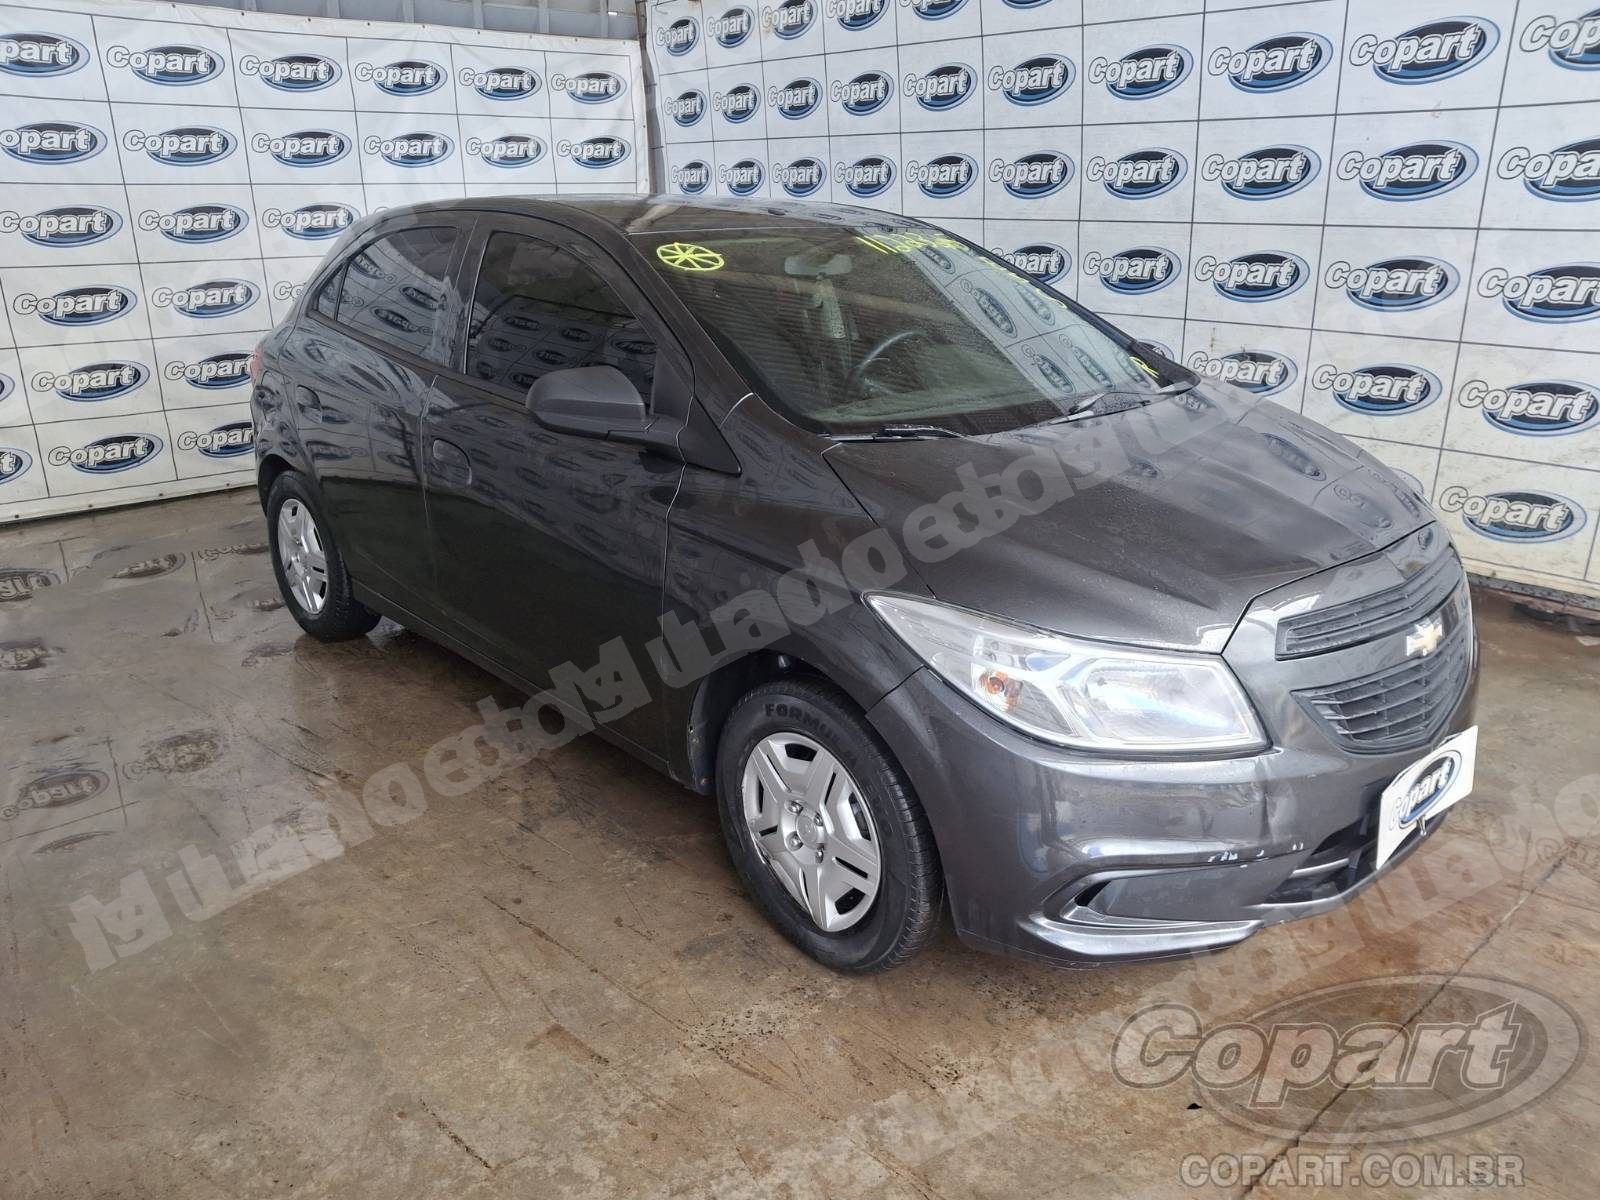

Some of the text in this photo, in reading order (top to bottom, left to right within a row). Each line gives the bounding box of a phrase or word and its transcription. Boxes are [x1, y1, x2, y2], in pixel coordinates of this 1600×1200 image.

[705, 9, 749, 42] Copart
[761, 0, 812, 32] Copart
[656, 19, 694, 49] Copart
[1349, 23, 1482, 73] Copart
[1519, 15, 1600, 58] Cop
[0, 38, 72, 65] part
[107, 45, 211, 76] Copart
[1208, 39, 1318, 82] Copart
[240, 55, 330, 83] Copart
[355, 62, 438, 87] Copart
[459, 67, 533, 92] Copart
[551, 73, 618, 95] Copart
[903, 67, 970, 102] Copart
[988, 59, 1065, 96] Copart
[1088, 50, 1180, 89] Copart
[665, 93, 703, 117] Copart
[712, 87, 755, 114] Copart
[767, 80, 817, 110] Copart
[830, 73, 886, 106] Copart
[0, 126, 91, 154] opart
[123, 129, 224, 158] Copart
[251, 133, 340, 159] Copart
[363, 135, 446, 159] Copart
[466, 137, 538, 160] Copart
[557, 140, 621, 160] Copart
[671, 161, 709, 187] Copart
[719, 160, 761, 188] Copart
[772, 159, 822, 189] Copart
[834, 158, 891, 189] Copart
[906, 155, 972, 189] Copart
[989, 155, 1065, 189] Copart
[1086, 152, 1176, 188] Copart
[1202, 152, 1307, 189] Copart
[1337, 148, 1463, 188] Copart
[1497, 147, 1600, 187] Copa
[0, 208, 109, 239] Copart
[139, 207, 237, 237] Copart
[262, 205, 350, 233] Copart
[1083, 251, 1170, 284] Copart
[1195, 255, 1294, 289] Copart
[1324, 261, 1445, 299] Copart
[152, 283, 248, 312] Copart
[1477, 268, 1600, 308] Copar
[13, 290, 121, 319] Copart
[31, 364, 135, 396] Copart
[1188, 351, 1284, 386] Copart
[1312, 364, 1426, 402] Copart
[1458, 380, 1593, 423] Copart
[48, 437, 149, 468] Copart
[178, 428, 254, 452] Copar
[1440, 486, 1568, 531] Copart
